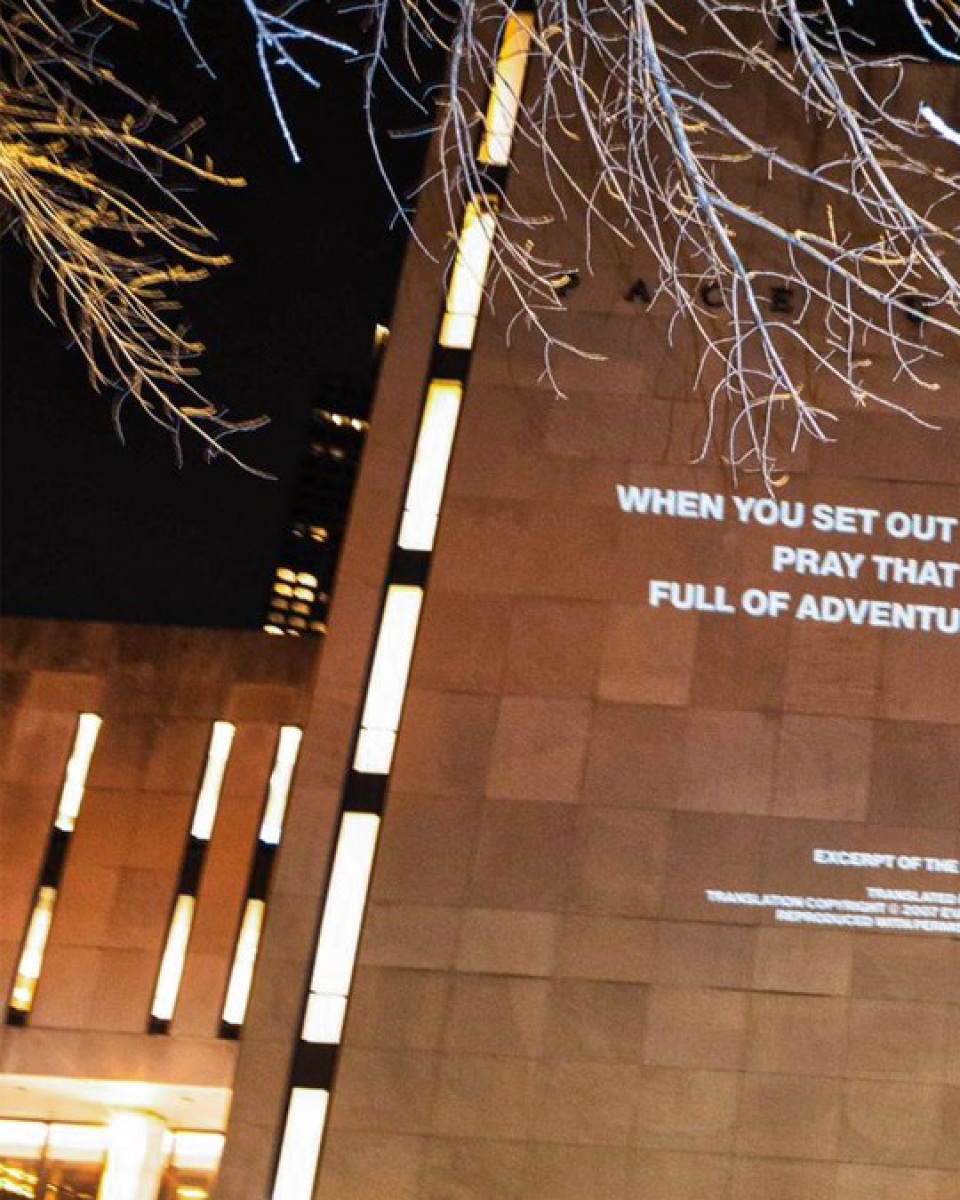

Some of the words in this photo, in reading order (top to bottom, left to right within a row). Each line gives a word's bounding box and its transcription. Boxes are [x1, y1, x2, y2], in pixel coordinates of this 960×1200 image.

[556, 271, 792, 313] PACE
[616, 484, 724, 520] WHEN
[733, 495, 804, 528] YOU
[812, 504, 880, 536] SET
[886, 512, 958, 543] OUT
[772, 545, 865, 580] PRAY
[871, 554, 960, 589] THAT
[648, 579, 736, 615] FULL
[741, 588, 791, 617] OF
